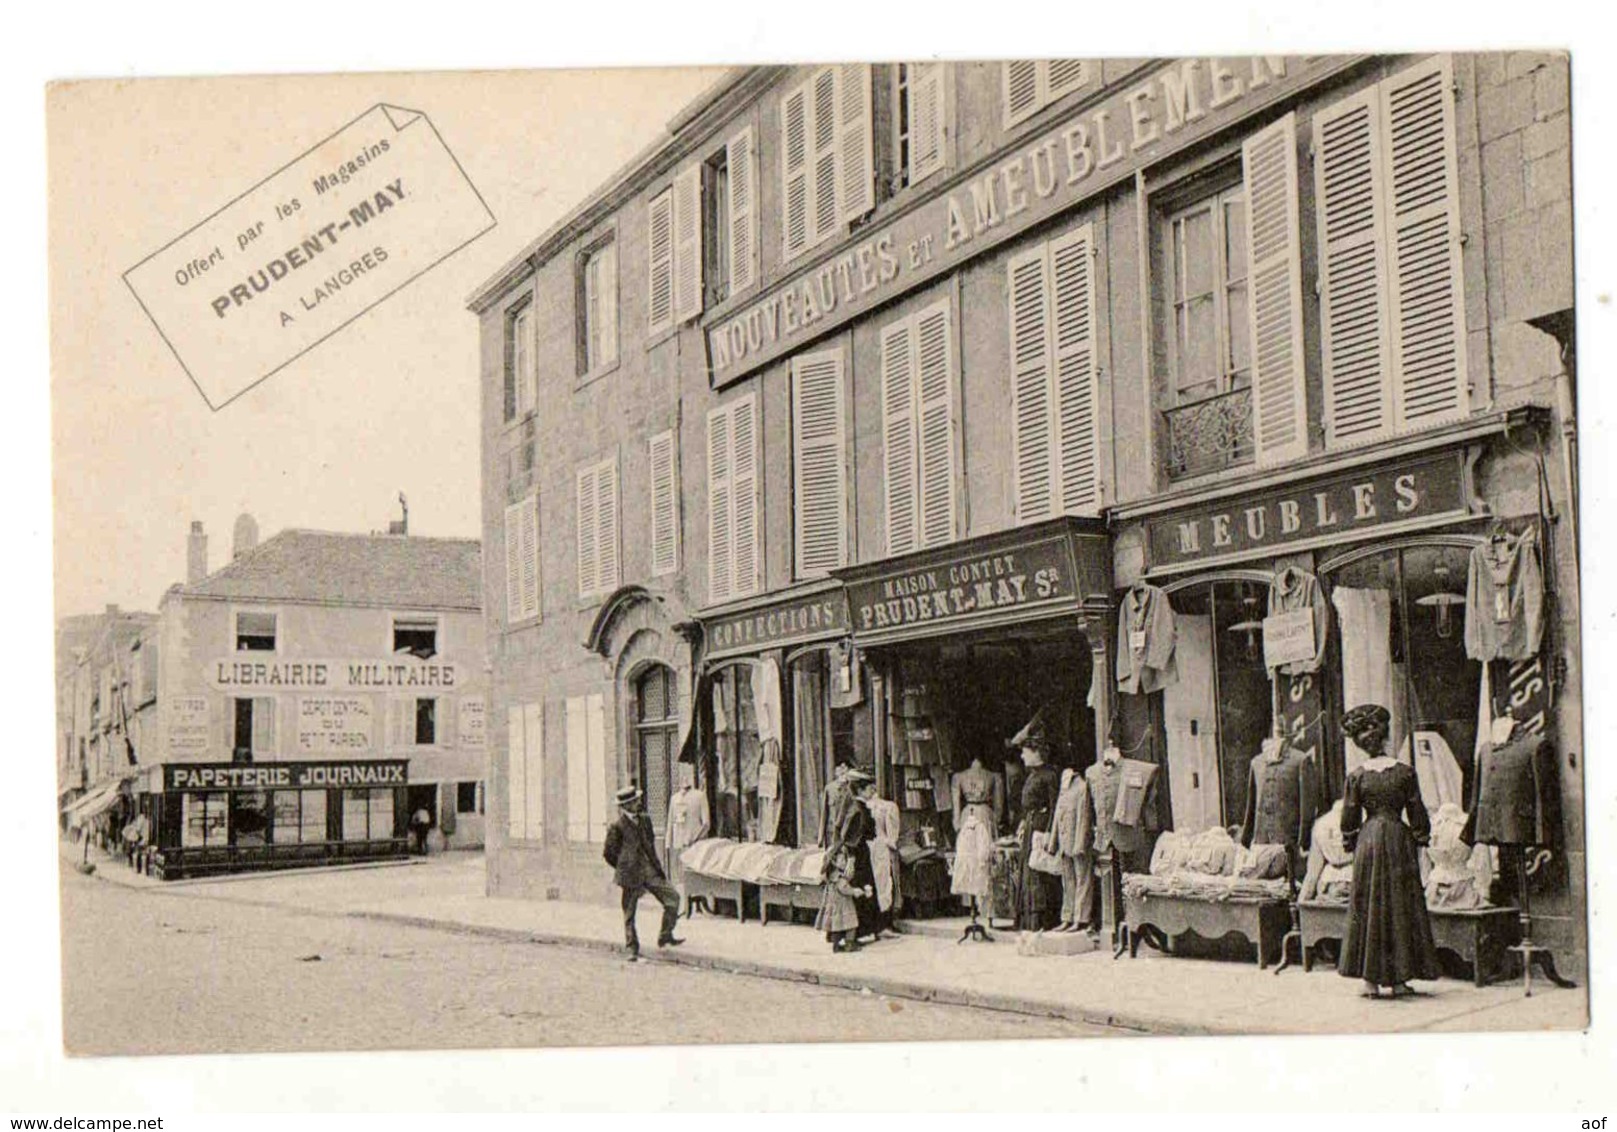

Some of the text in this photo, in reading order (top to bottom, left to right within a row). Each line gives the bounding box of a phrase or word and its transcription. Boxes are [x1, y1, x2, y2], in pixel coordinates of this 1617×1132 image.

[714, 55, 1328, 370] NOUVEAUTES ET AMEUBLEMEN
[1176, 473, 1420, 554] MEUBLES
[884, 572, 937, 599] MAISON
[714, 601, 834, 646] CONFECTIONS
[217, 663, 455, 686] LIBRAIRIE MILITAIRE
[173, 766, 405, 787] PAPETERIE JOURNAUX
